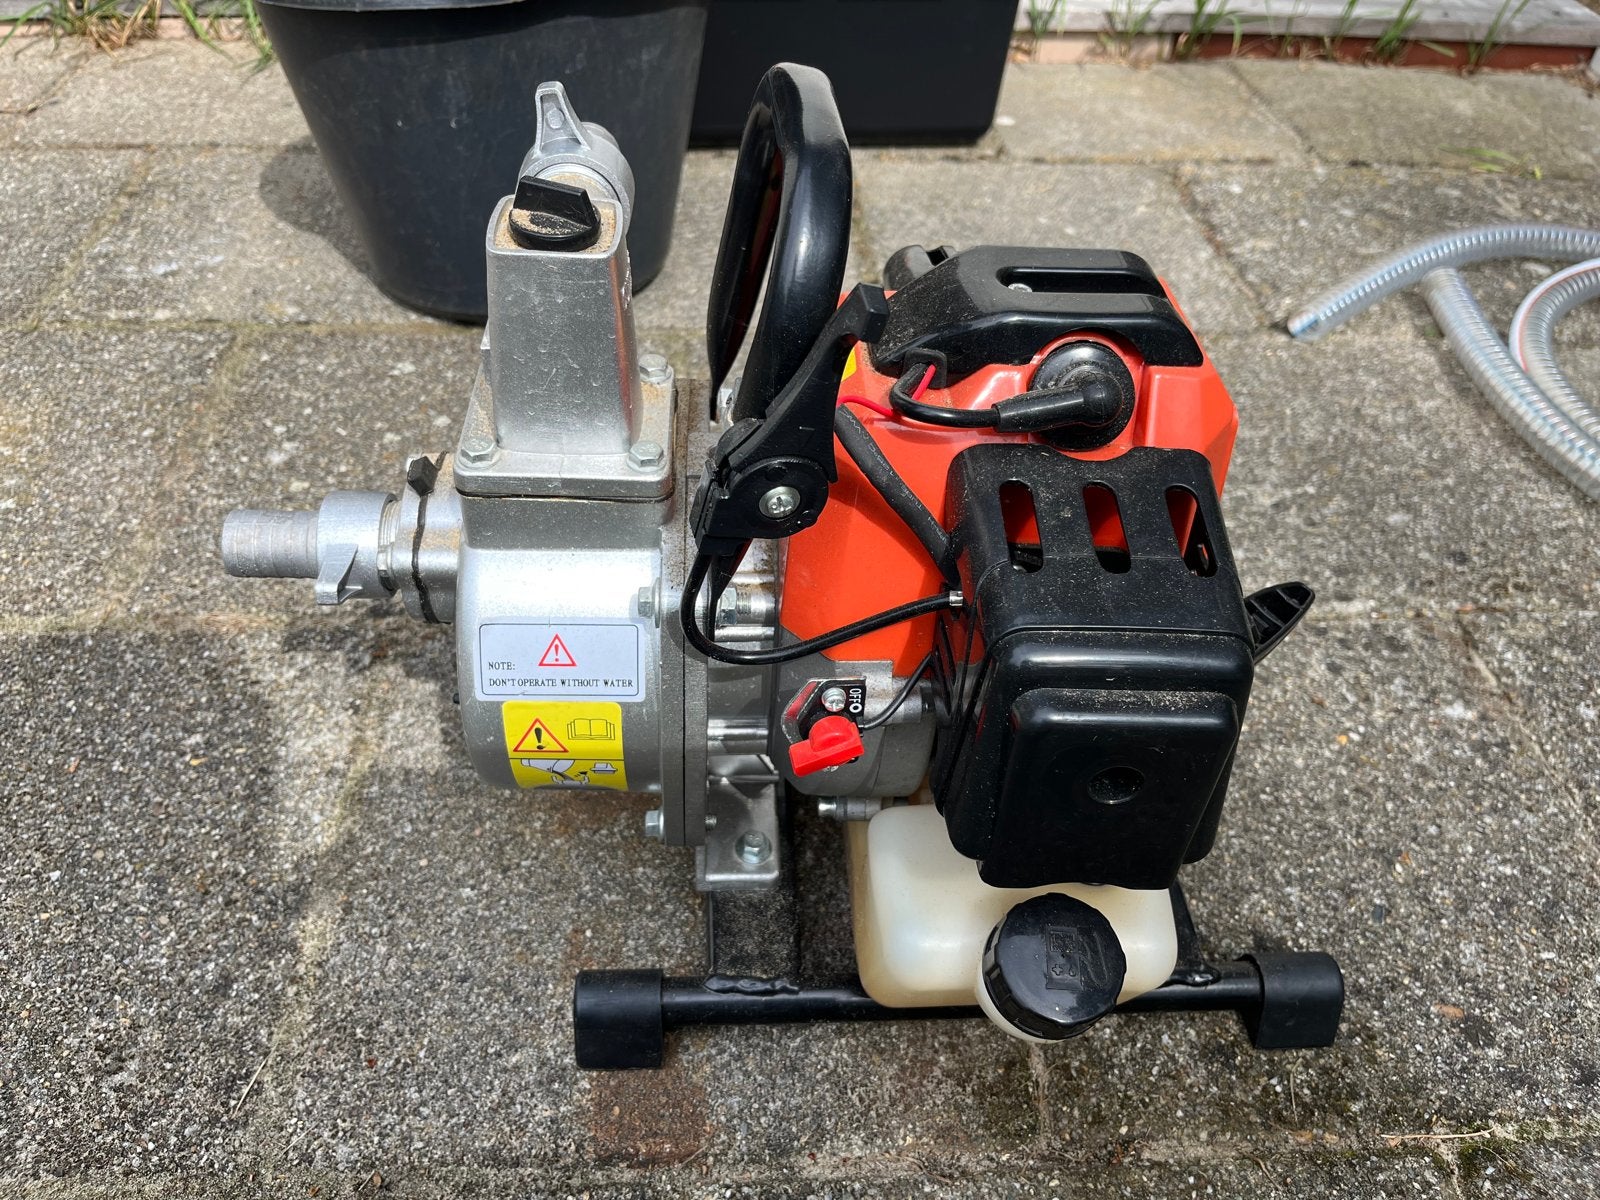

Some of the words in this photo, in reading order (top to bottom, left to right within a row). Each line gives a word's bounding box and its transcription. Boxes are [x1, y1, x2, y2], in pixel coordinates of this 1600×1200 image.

[488, 661, 516, 671] NOTE:
[489, 678, 516, 687] DON'T
[517, 678, 557, 687] OPERATE
[560, 678, 599, 687] WITHOUT
[604, 678, 634, 688] WATER
